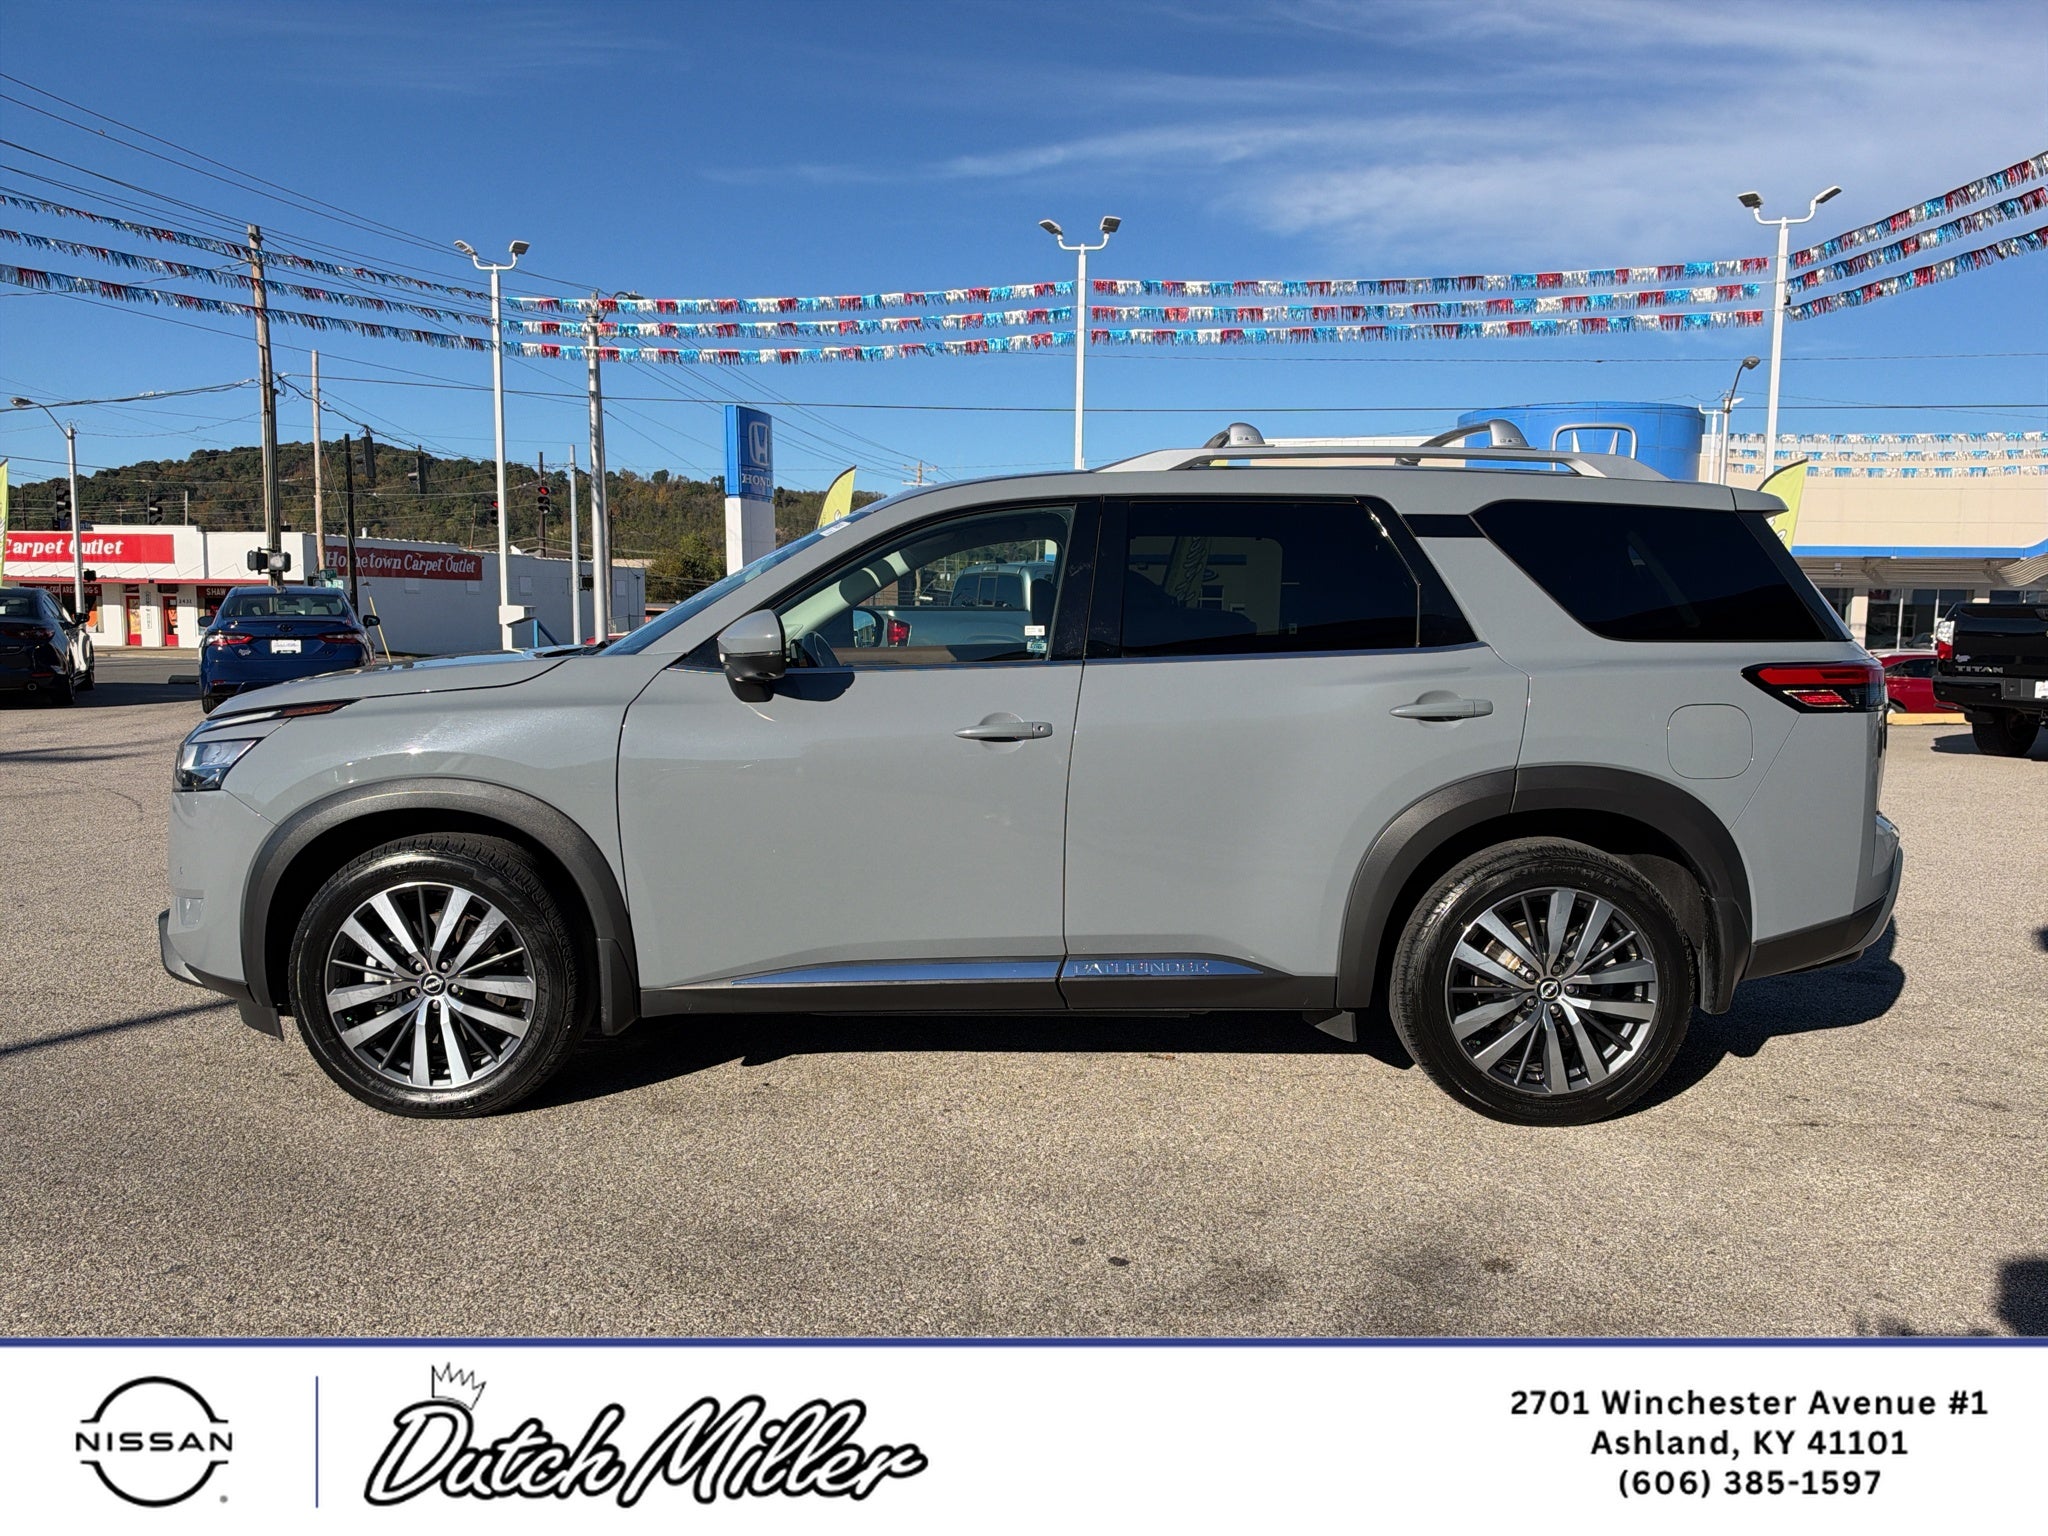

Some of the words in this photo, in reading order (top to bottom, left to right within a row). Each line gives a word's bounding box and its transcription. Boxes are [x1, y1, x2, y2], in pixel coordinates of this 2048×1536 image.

[404, 554, 443, 575] Carpet
[446, 557, 476, 573] Outlet
[1955, 665, 2004, 674] TITAN
